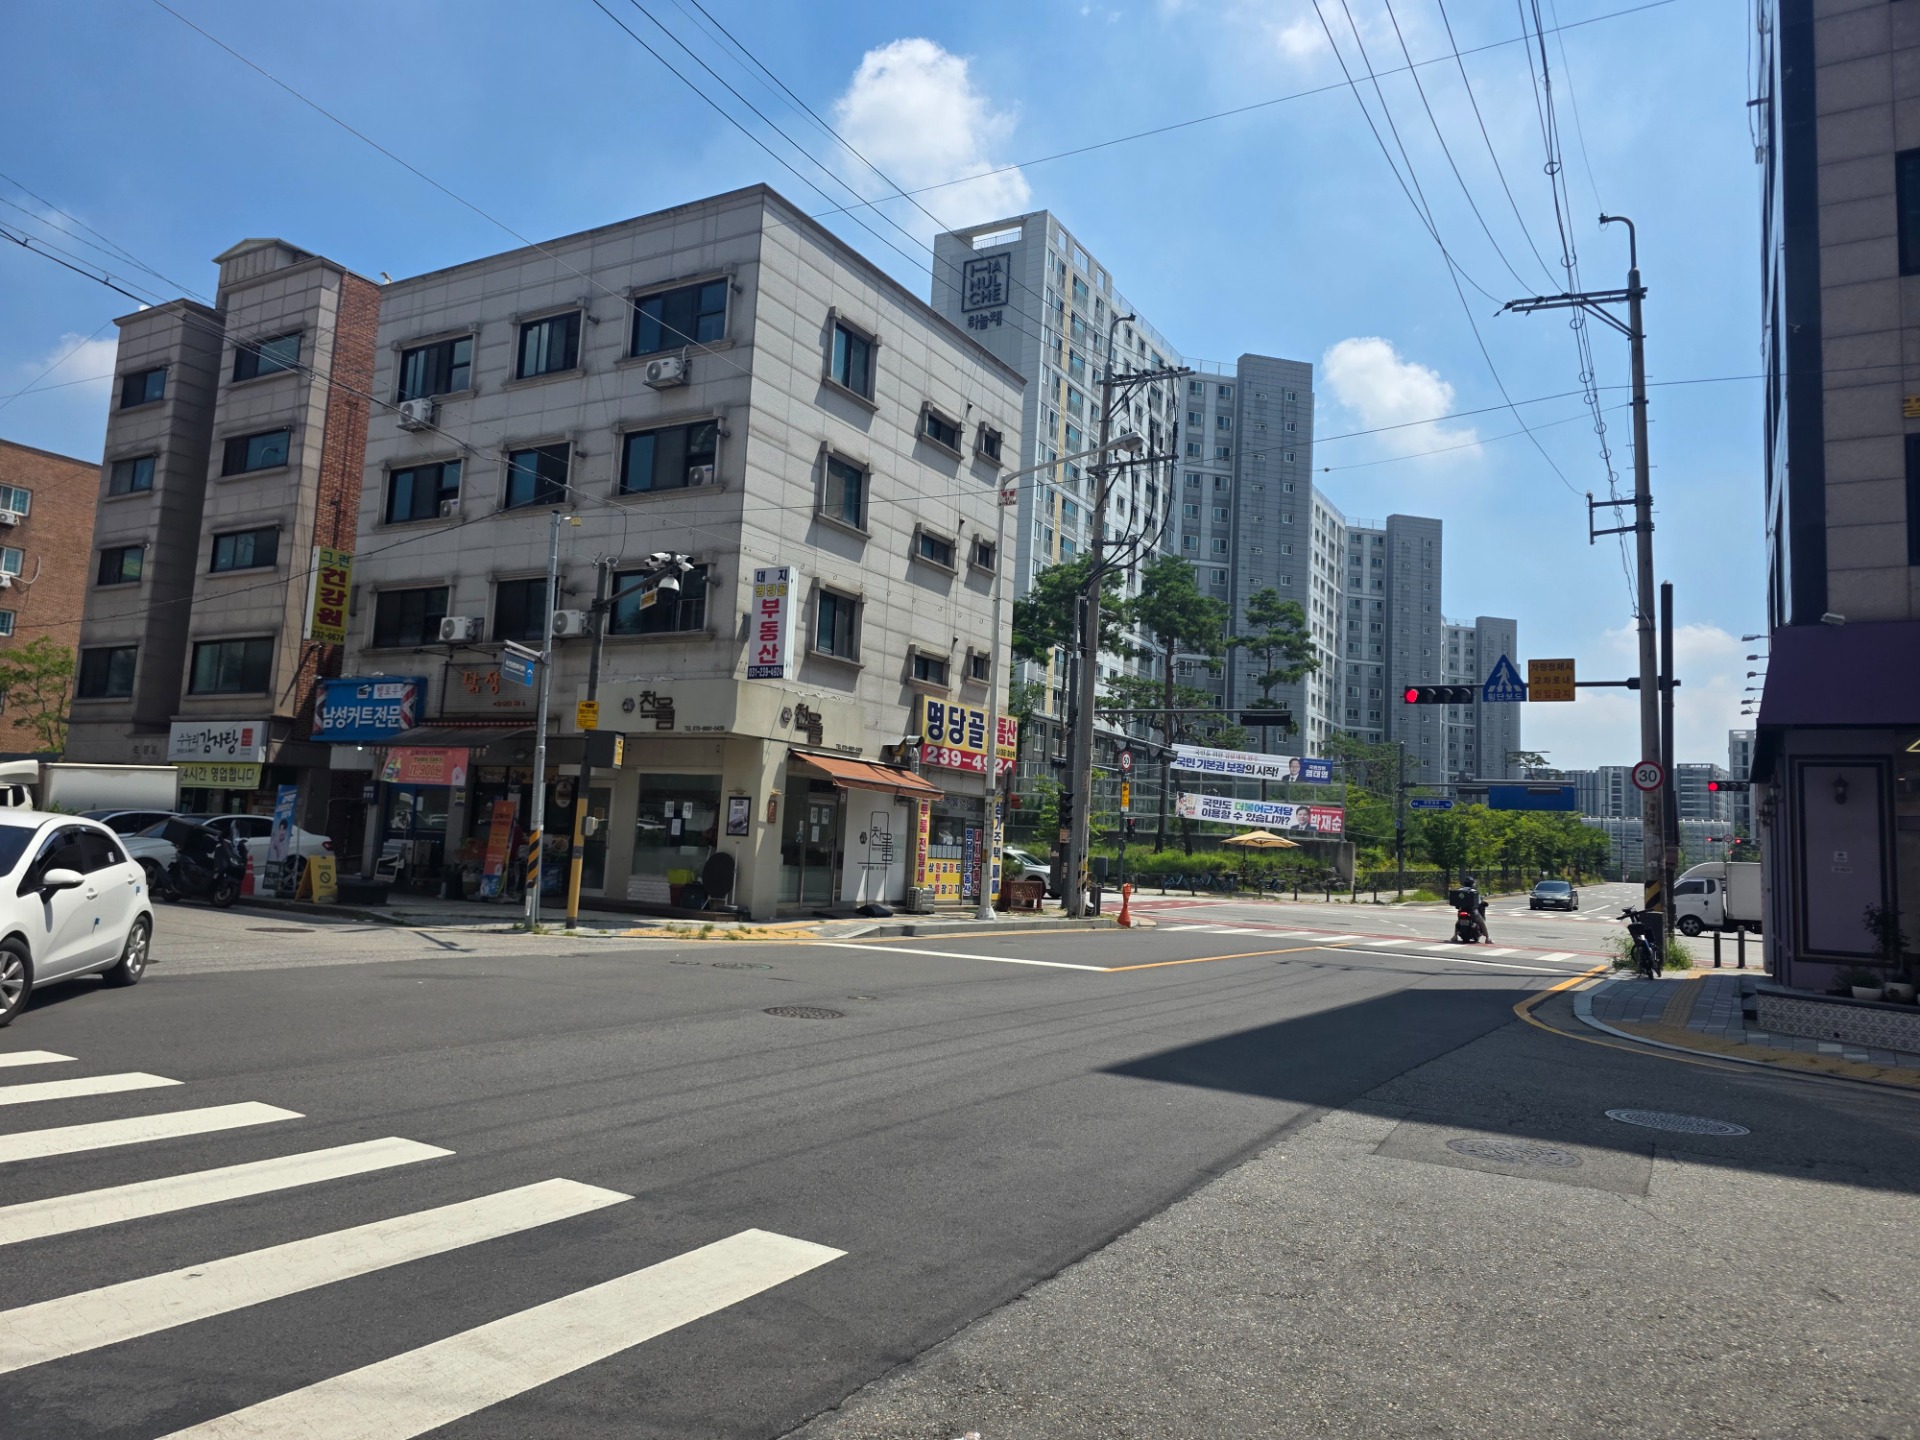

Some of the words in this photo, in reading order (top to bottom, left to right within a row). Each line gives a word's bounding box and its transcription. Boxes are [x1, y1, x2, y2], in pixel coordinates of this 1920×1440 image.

[969, 274, 1002, 292] NUL
[969, 286, 1001, 305] CHE
[967, 310, 1003, 330] 하늘채
[316, 567, 348, 628] 건강원
[758, 598, 781, 664] 부동산
[1487, 692, 1523, 701] 횡단보도
[1533, 689, 1571, 699] 진입금지
[322, 705, 401, 728] 남성커트전문
[927, 700, 985, 750] 명당골
[200, 728, 239, 755] 감자탕
[1123, 756, 1130, 765] 50
[1176, 756, 1196, 768] 국민
[1197, 759, 1225, 772] 기본권
[1226, 762, 1255, 775] 보장의
[1256, 766, 1279, 778] 시작!
[181, 766, 207, 781] 4시간
[210, 766, 255, 782] 영업합니다
[1639, 769, 1658, 783] 30
[1202, 797, 1232, 810] 국민도
[1234, 802, 1293, 816] 더불어근저당
[1201, 807, 1231, 820] 이용할
[1233, 811, 1243, 821] 수
[1245, 812, 1291, 826] 있습니까?
[1310, 813, 1342, 832] 박재순
[916, 838, 927, 883] 전월세
